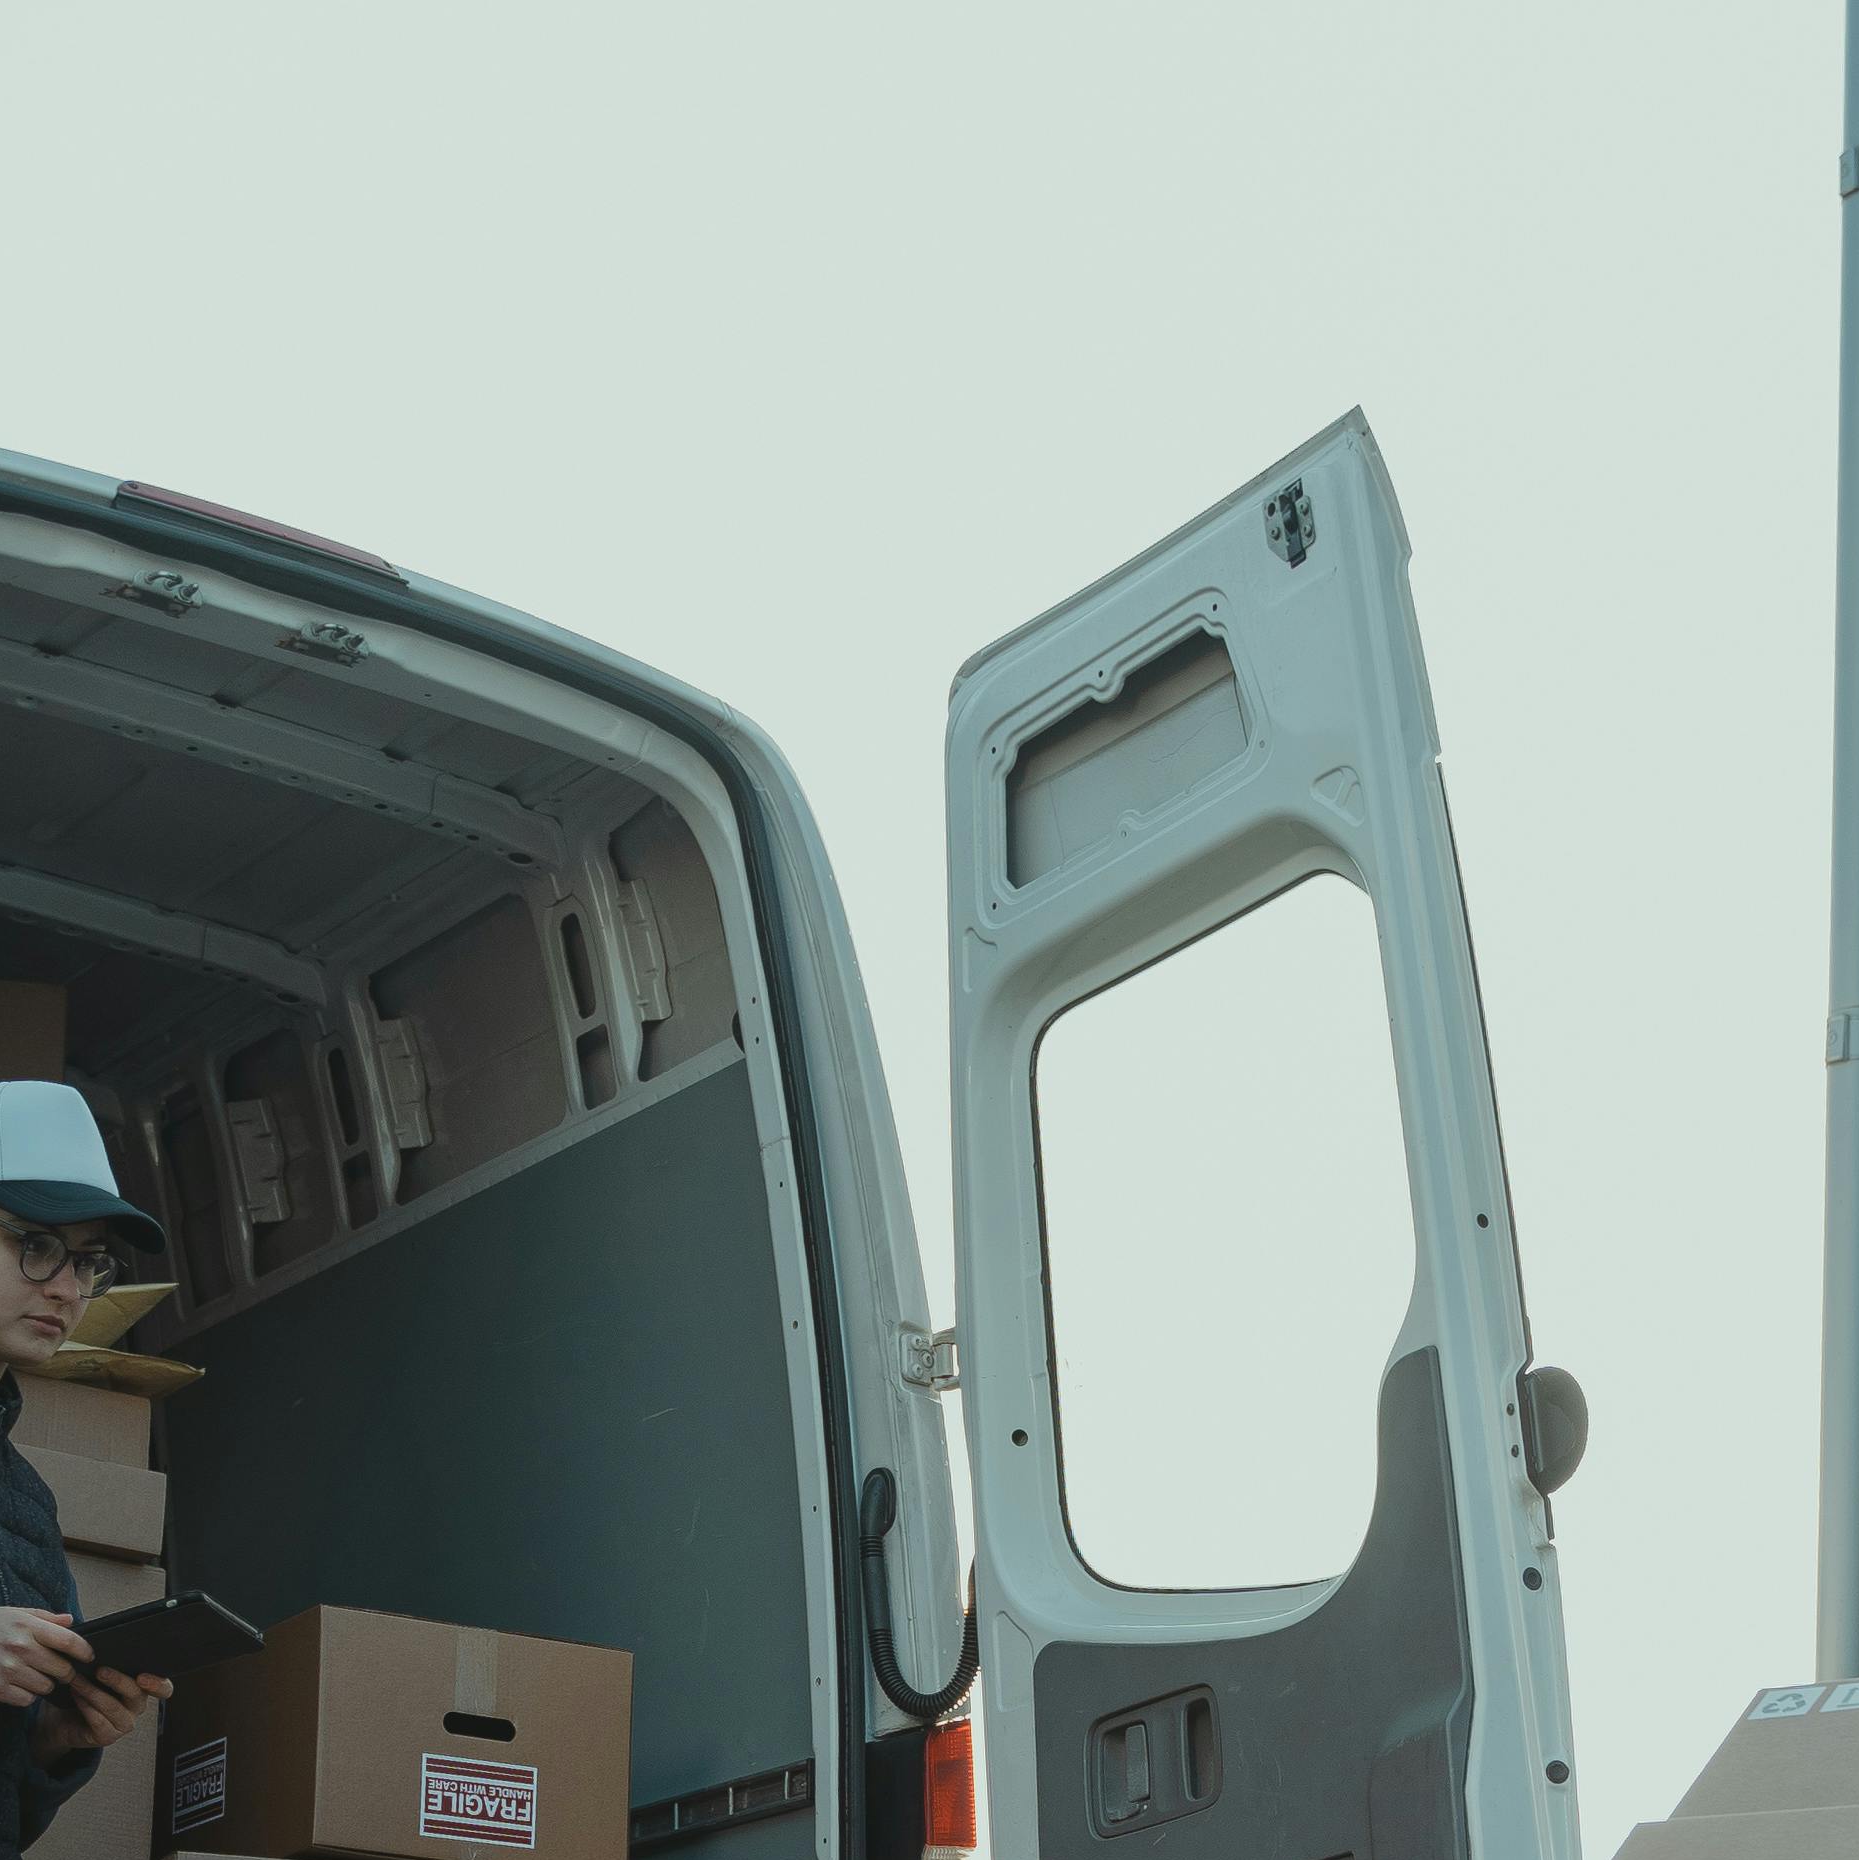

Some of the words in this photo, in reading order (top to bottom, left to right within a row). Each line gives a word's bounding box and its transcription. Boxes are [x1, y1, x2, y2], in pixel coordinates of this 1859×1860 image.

[176, 1772, 223, 1808] FRAGILE
[428, 1778, 457, 1791] CARE
[460, 1782, 487, 1795] WITH
[489, 1786, 531, 1800] HANDLE
[427, 1789, 531, 1821] FRAGILE
